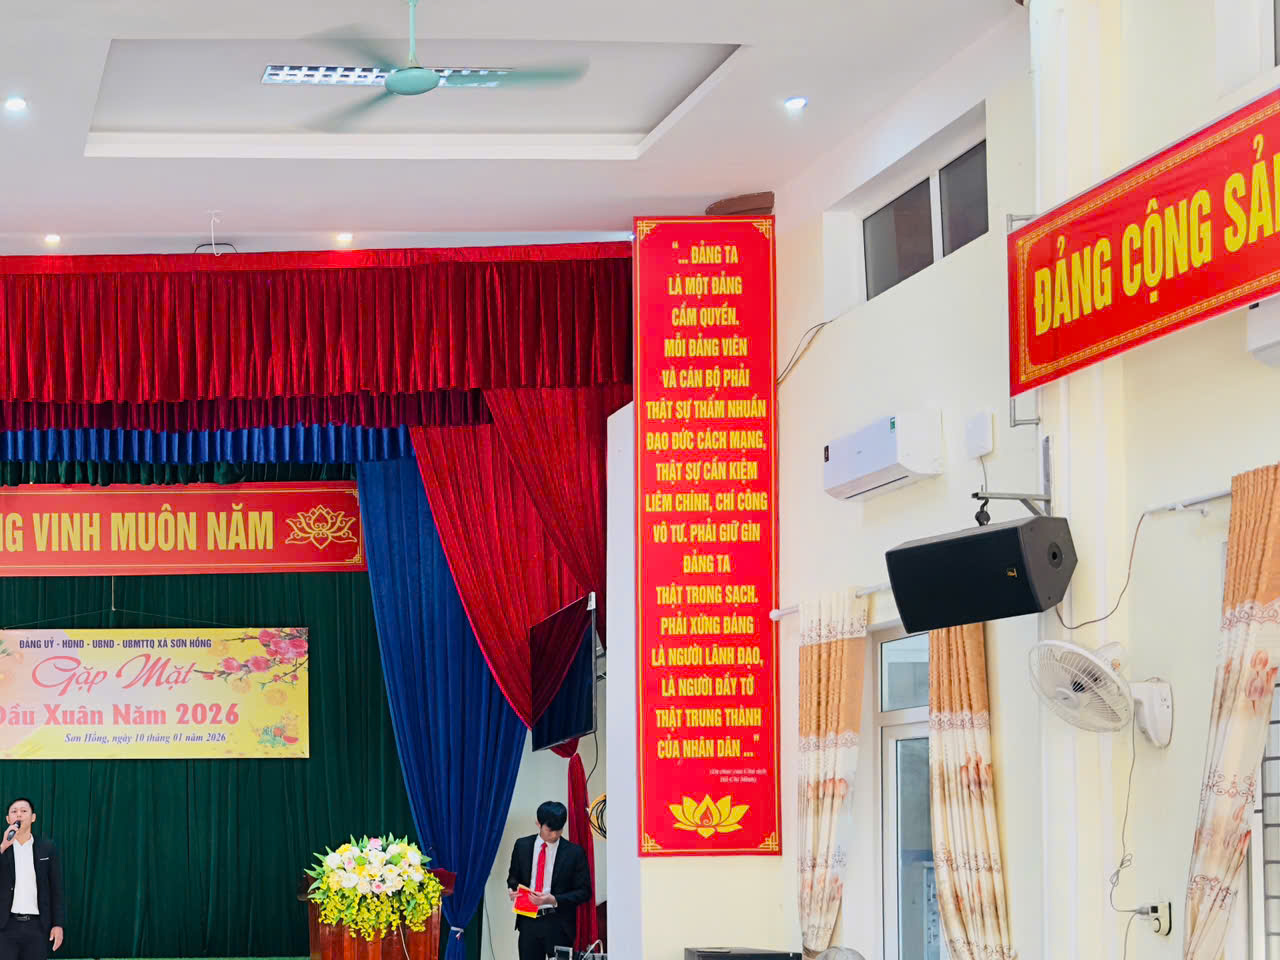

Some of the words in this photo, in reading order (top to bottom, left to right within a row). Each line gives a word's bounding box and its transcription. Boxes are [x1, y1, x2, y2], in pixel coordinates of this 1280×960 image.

[723, 245, 739, 265] TA
[1033, 234, 1113, 337] ĐẢNG
[1121, 188, 1213, 304] CỘNG
[32, 512, 101, 552] VINH
[110, 503, 197, 552] MUÔN
[207, 502, 274, 550] NĂM
[715, 555, 732, 573] TA
[684, 585, 723, 605] TRONG
[19, 636, 42, 649] ĐẢNG
[62, 639, 85, 649] HĐND
[92, 639, 115, 649] UBND
[122, 639, 155, 650] UBMTTQ
[31, 655, 109, 697] Gặp
[115, 653, 197, 691] Mặt
[43, 703, 104, 726] Xuân
[112, 703, 167, 726] Năm
[175, 703, 240, 725] 2026
[684, 709, 723, 728] TRUNG
[206, 732, 227, 742] 2026
